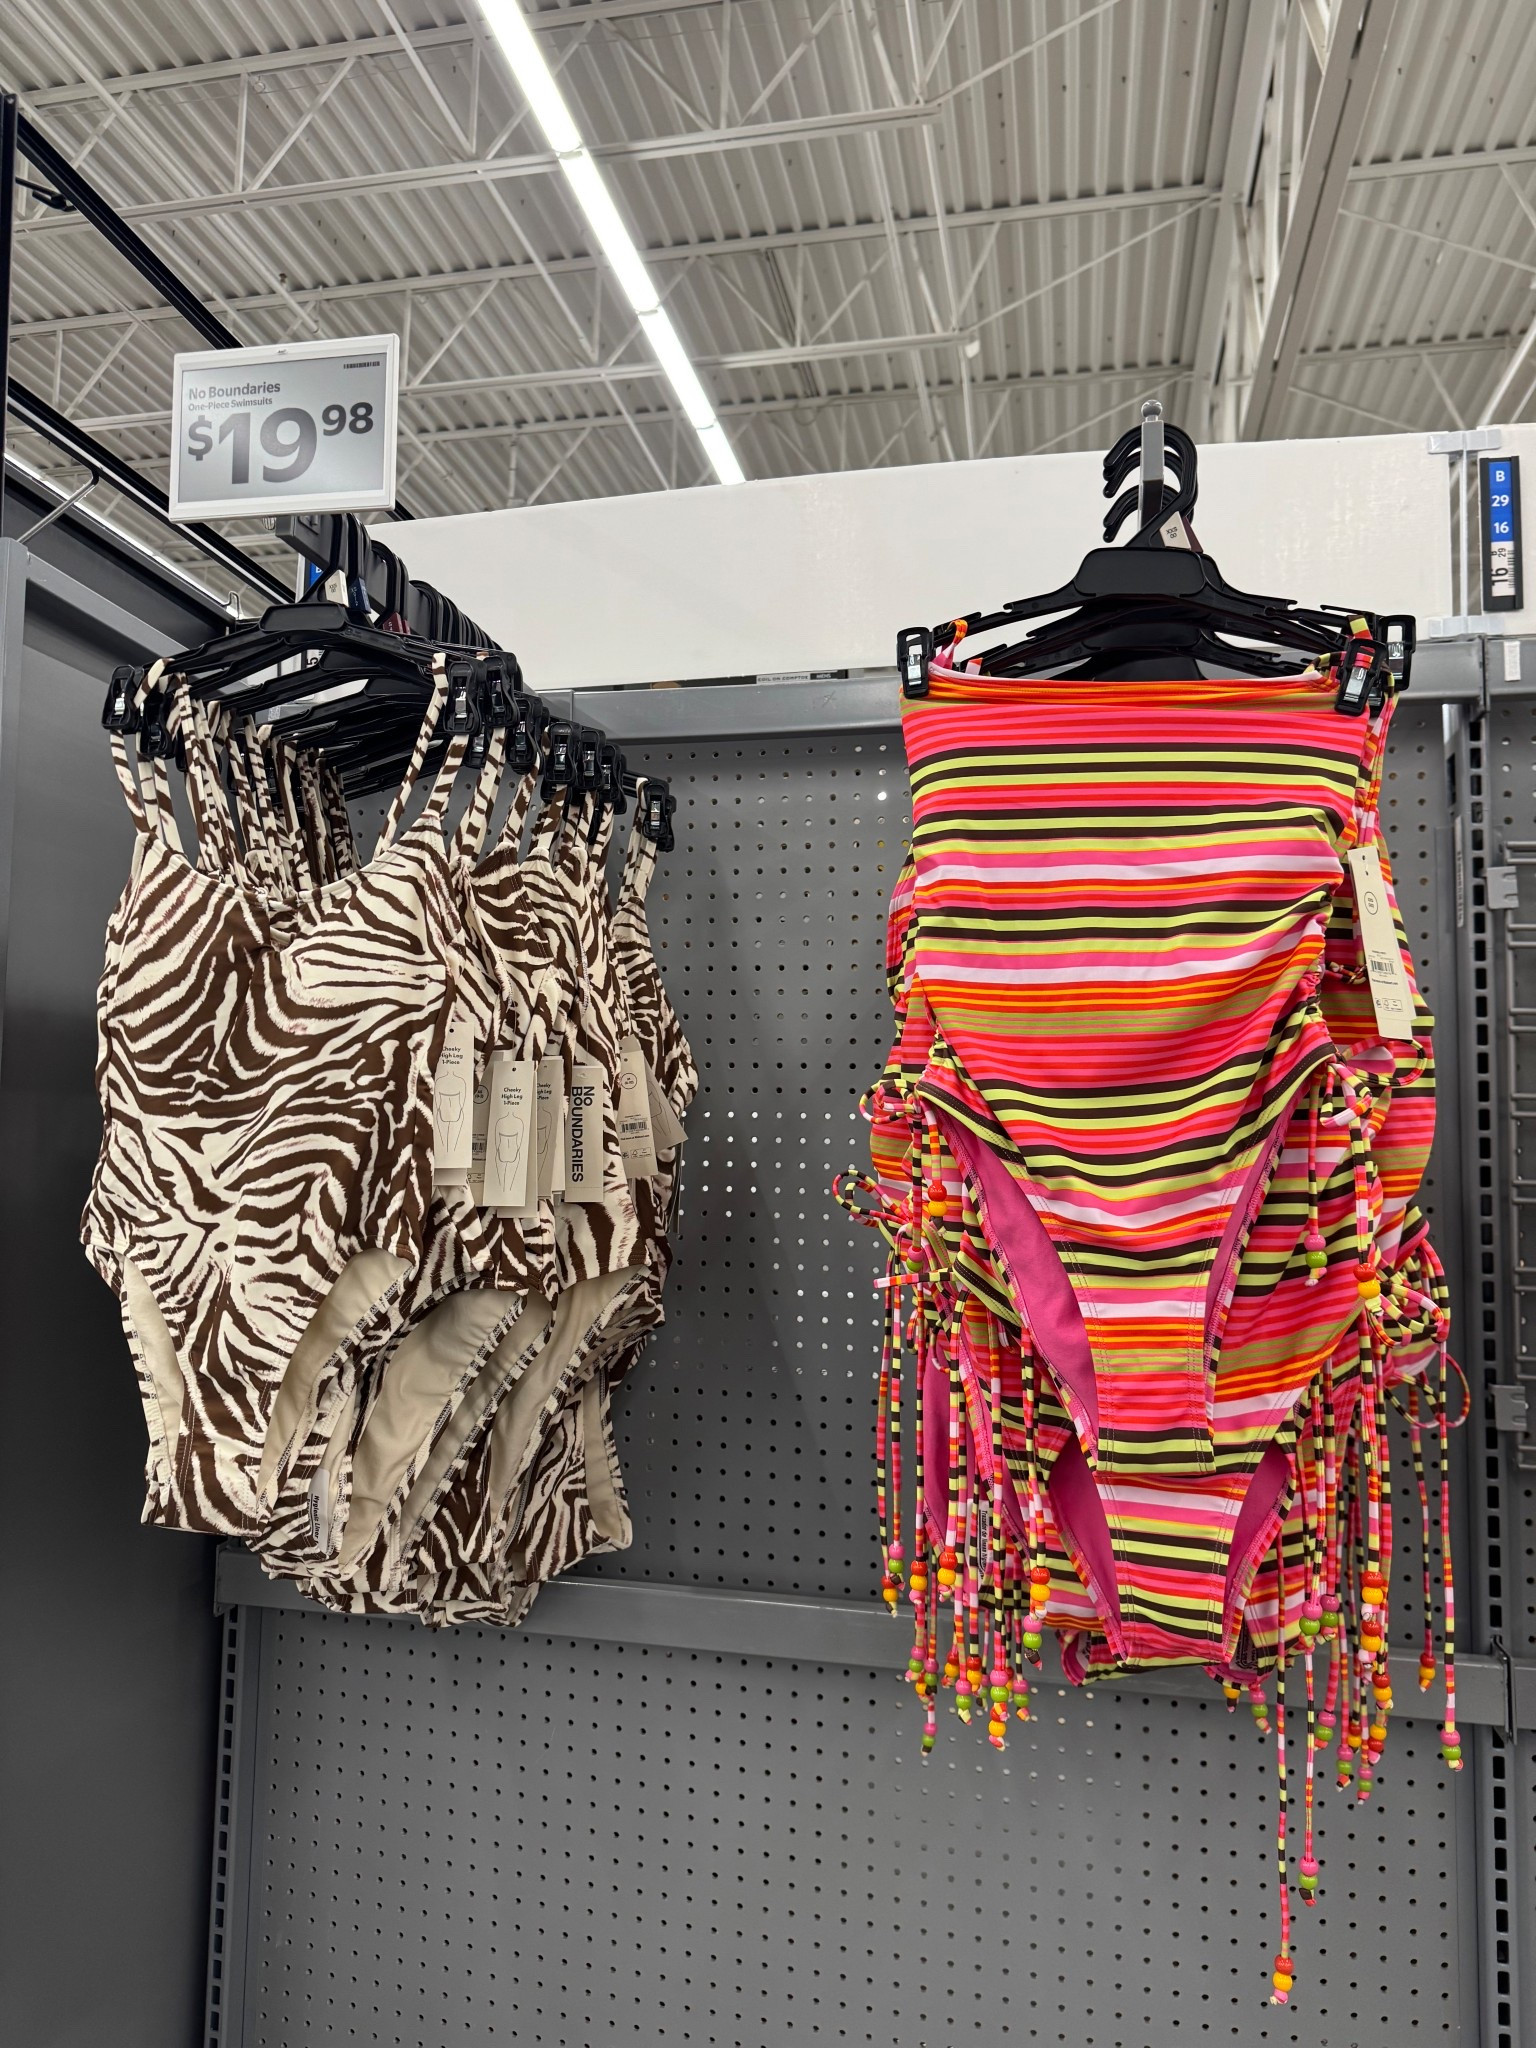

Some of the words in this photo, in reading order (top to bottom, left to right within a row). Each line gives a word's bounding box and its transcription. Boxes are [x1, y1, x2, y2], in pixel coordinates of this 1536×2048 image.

[188, 387, 206, 401] No
[208, 381, 281, 398] Boundaries
[188, 400, 230, 411] One-Piece
[230, 397, 273, 408] Swimsuits
[1495, 470, 1506, 482] B
[1491, 494, 1510, 507] 29
[1493, 521, 1510, 534] 16
[1497, 547, 1506, 558] 29
[1491, 567, 1509, 587] 16
[583, 1086, 595, 1107] NO
[571, 1086, 584, 1183] BOUNDARIES
